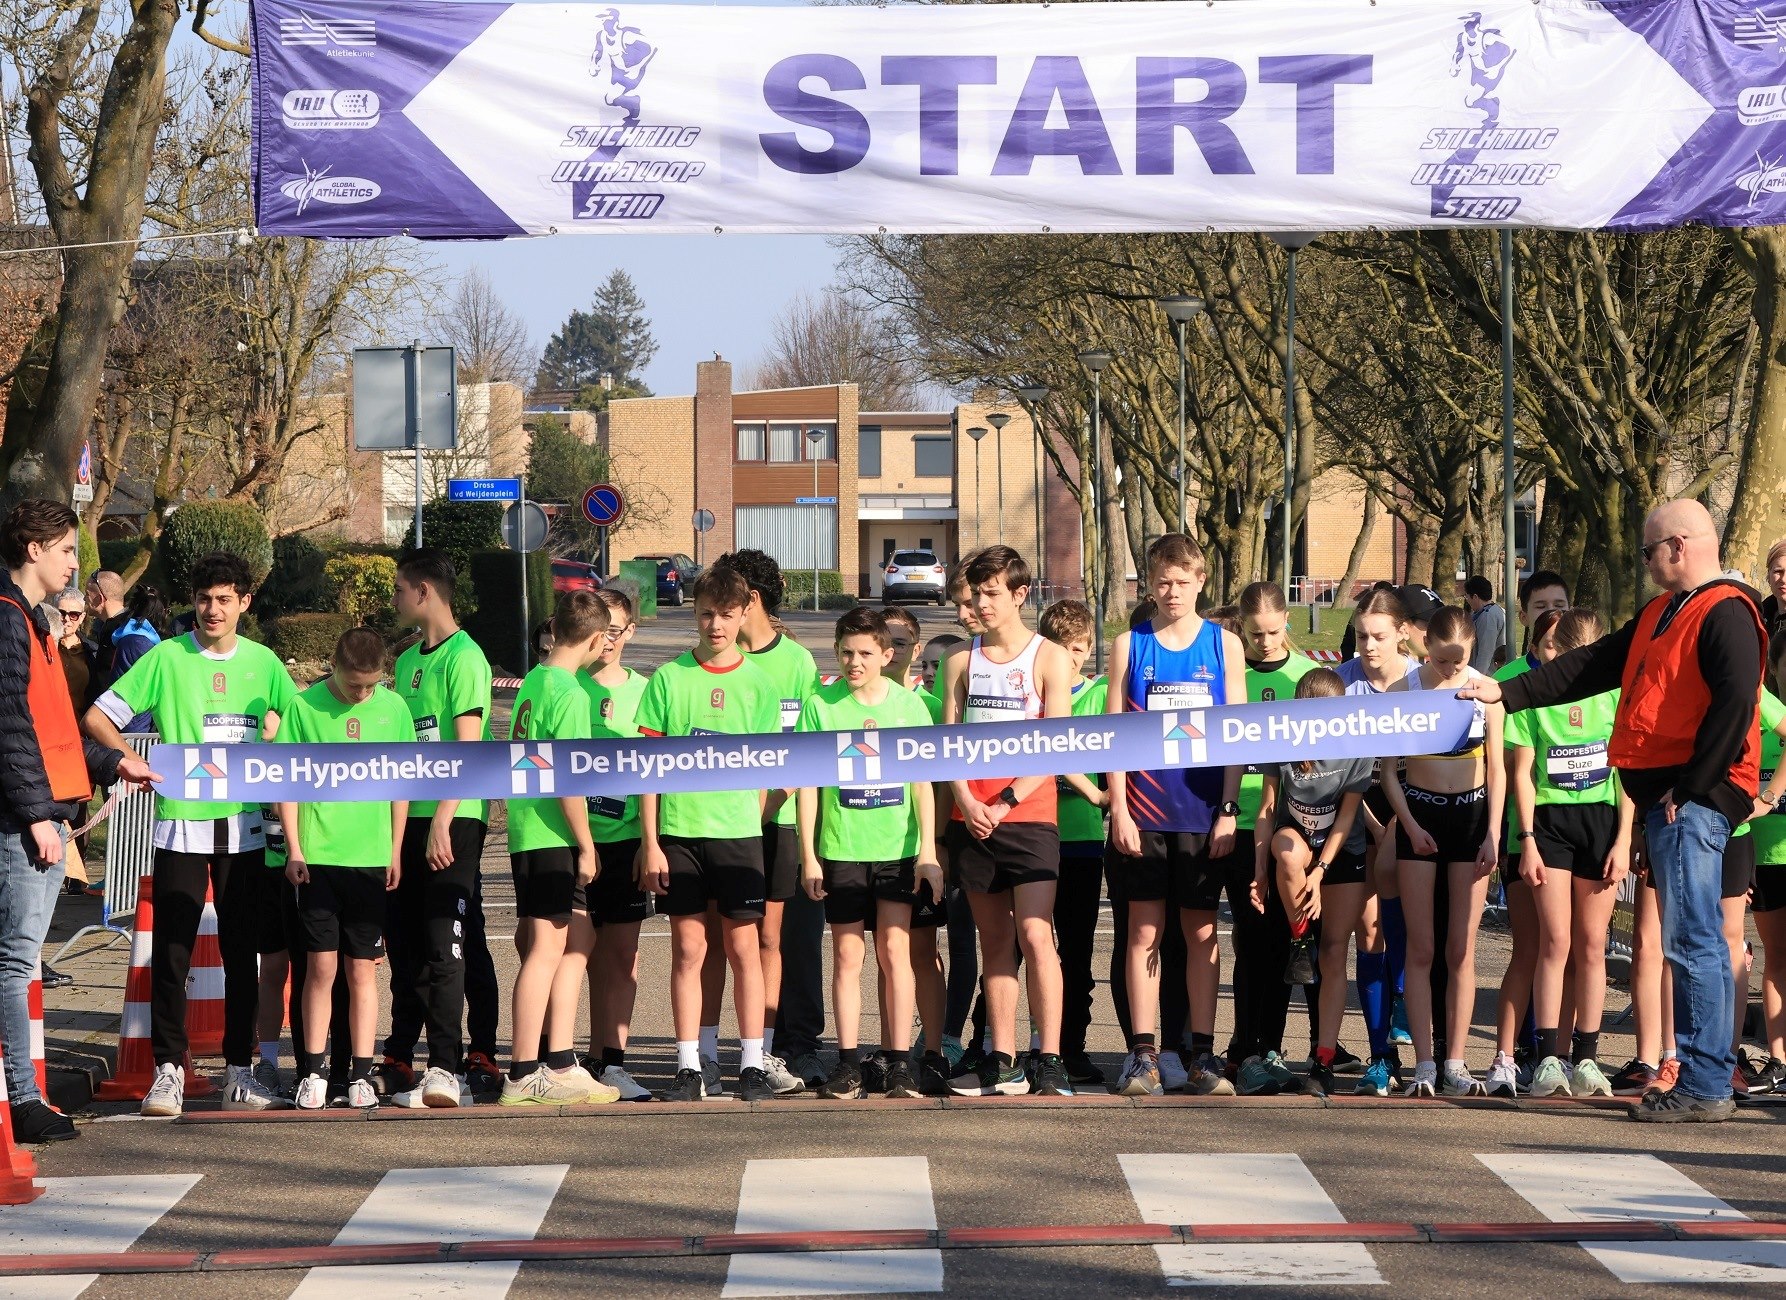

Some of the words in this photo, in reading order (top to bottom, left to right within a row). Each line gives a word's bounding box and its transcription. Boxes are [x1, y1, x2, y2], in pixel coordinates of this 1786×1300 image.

[326, 49, 375, 58] Atletiekunie
[292, 97, 326, 111] IAU
[1747, 92, 1776, 107] IAU
[758, 53, 1374, 176] START
[559, 125, 702, 148] STICHTING
[1419, 127, 1560, 150] STICHTING
[551, 160, 707, 183] ULTRALOOP
[1410, 163, 1562, 186] ULTRALOOP
[315, 188, 373, 197] ATHLETICS
[577, 195, 662, 217] STEIN
[1435, 198, 1518, 219] STEIN
[454, 490, 464, 498] vd
[465, 490, 514, 498] Weijdenplein
[1152, 685, 1209, 694] LOOPFESTEIN
[969, 698, 1021, 709] LOOPFESTEIN
[1167, 697, 1194, 707] Timo
[207, 716, 257, 726] LOOPFESTEIN
[1222, 717, 1262, 743] De
[1268, 706, 1441, 746] Hypotheker
[227, 729, 245, 739] Jad
[896, 738, 936, 761] De
[942, 727, 1115, 764] Hypotheker
[1551, 742, 1605, 757] LOOPFESTEIN
[570, 751, 610, 774] De
[616, 744, 789, 779] Hypotheker
[1567, 760, 1593, 770] Suze
[244, 758, 284, 783] De
[290, 754, 463, 789] Hypotheker
[1572, 771, 1590, 780] 255
[864, 789, 881, 797] 254
[1405, 788, 1448, 806] PRO
[1288, 797, 1336, 814] LOOPFESTEIN
[1302, 815, 1319, 828] Evy
